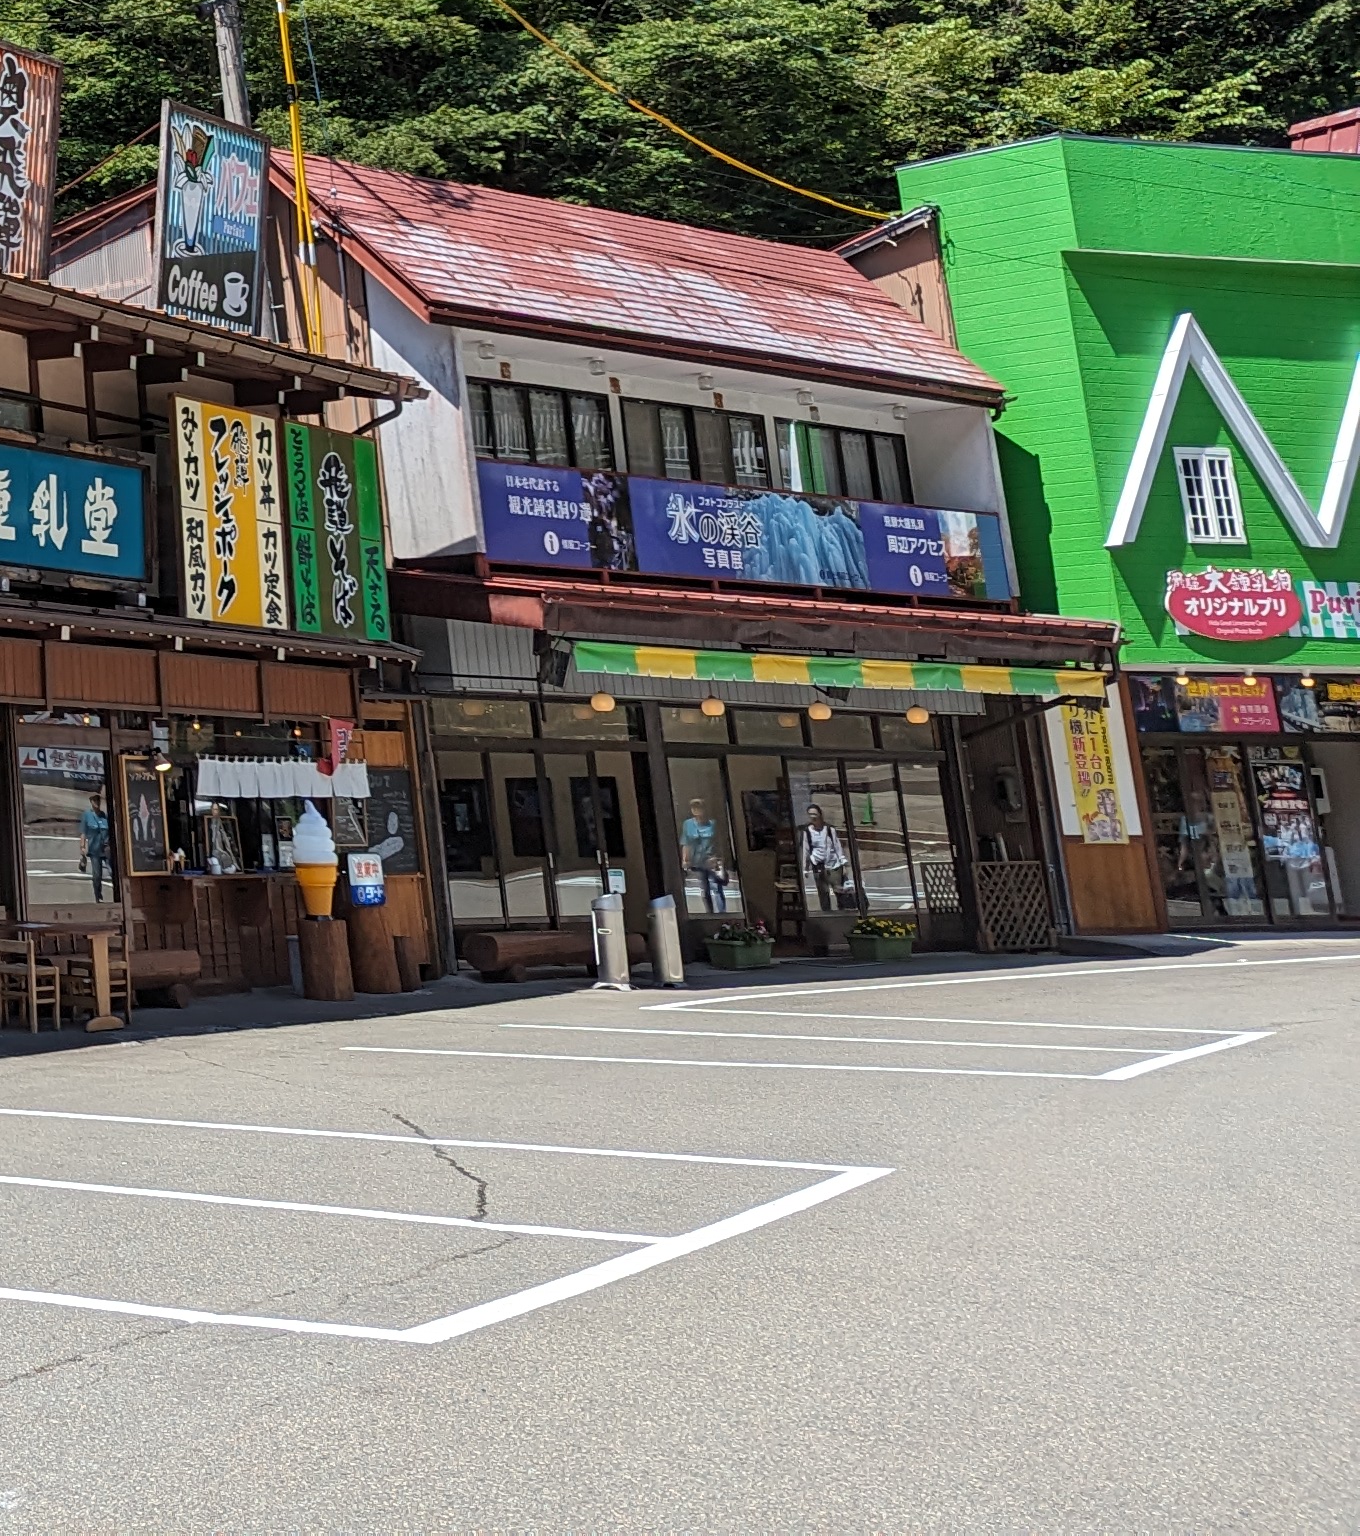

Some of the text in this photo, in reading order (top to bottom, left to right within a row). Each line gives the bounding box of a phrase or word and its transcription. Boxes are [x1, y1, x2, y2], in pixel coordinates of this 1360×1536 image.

[214, 156, 261, 217] パフェ
[220, 219, 248, 241] Parfait
[167, 263, 220, 314] Coffee
[254, 421, 276, 518] カツ丼
[208, 415, 239, 616] フレッシュポーク
[666, 492, 763, 549] 氷の渓谷
[185, 517, 208, 616] 和風カツ
[261, 526, 284, 626] カツ定食
[701, 547, 745, 570] 写真展
[1183, 596, 1287, 617] オリジナルプリ
